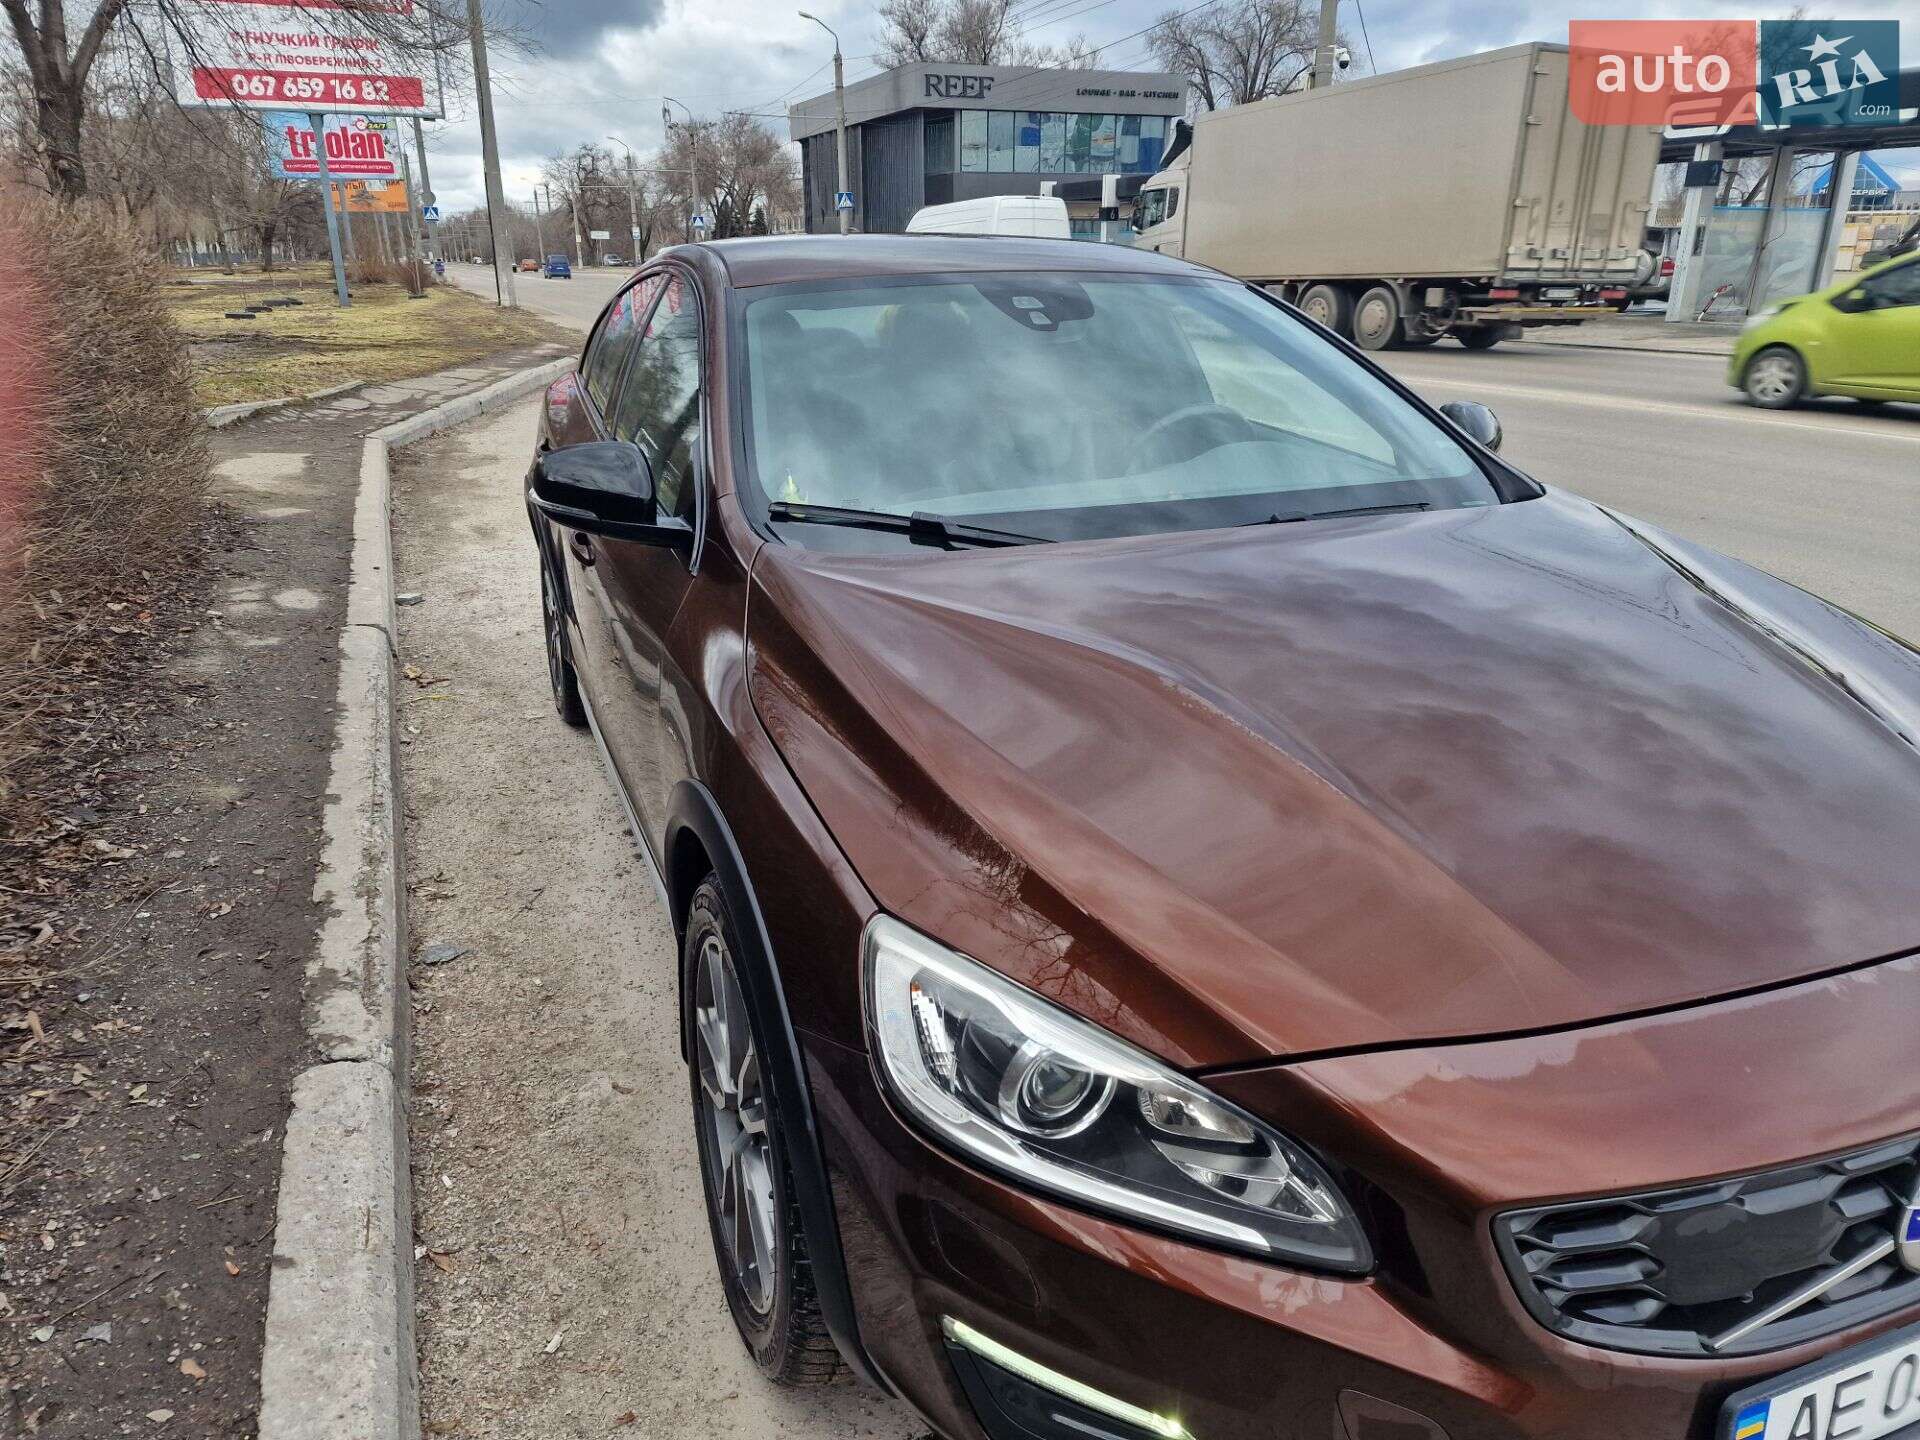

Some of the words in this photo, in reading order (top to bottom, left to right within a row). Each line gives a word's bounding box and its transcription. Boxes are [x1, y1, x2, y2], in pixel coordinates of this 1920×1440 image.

[243, 31, 320, 50] ГНУЧКИЙ
[231, 74, 277, 96] 067
[283, 76, 325, 99] 659
[330, 79, 357, 100] 16
[361, 80, 390, 101] 82
[924, 73, 995, 99] REEF
[1076, 88, 1112, 97] LOUNGE
[1119, 89, 1136, 97] BAR
[1143, 90, 1180, 99] KITCHEN
[284, 125, 386, 159] trolan
